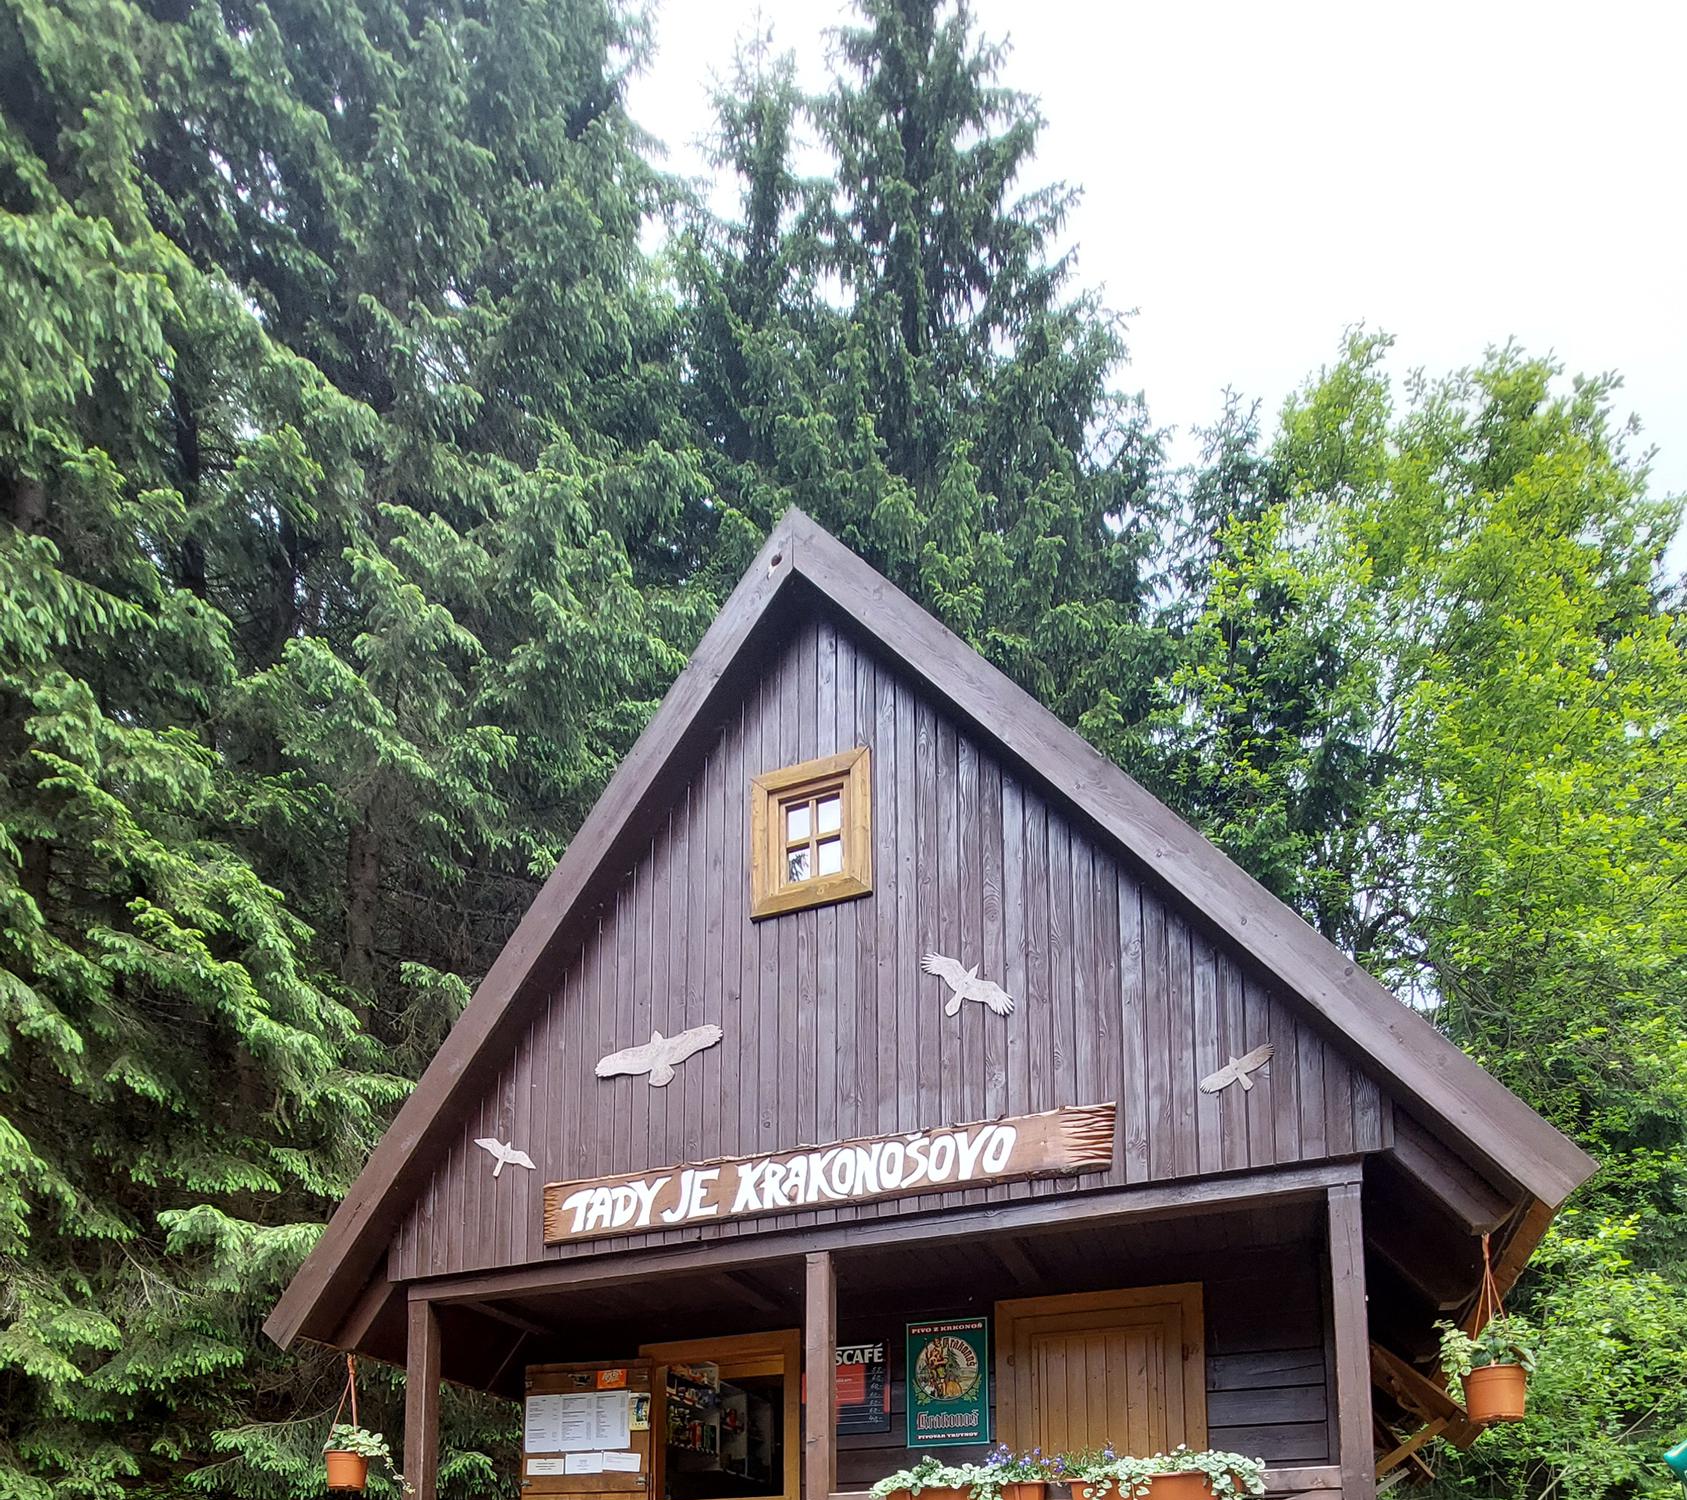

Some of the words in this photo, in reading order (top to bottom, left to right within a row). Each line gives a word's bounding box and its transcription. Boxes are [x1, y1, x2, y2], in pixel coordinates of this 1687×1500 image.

[562, 1177, 670, 1233] TADY
[661, 1168, 720, 1222] JE
[731, 1126, 1018, 1212] KRAKONOŠOVO
[940, 1322, 983, 1331] KRKONOŠ
[836, 1343, 884, 1366] SCAFÉ
[917, 1408, 979, 1430] Krakonoš
